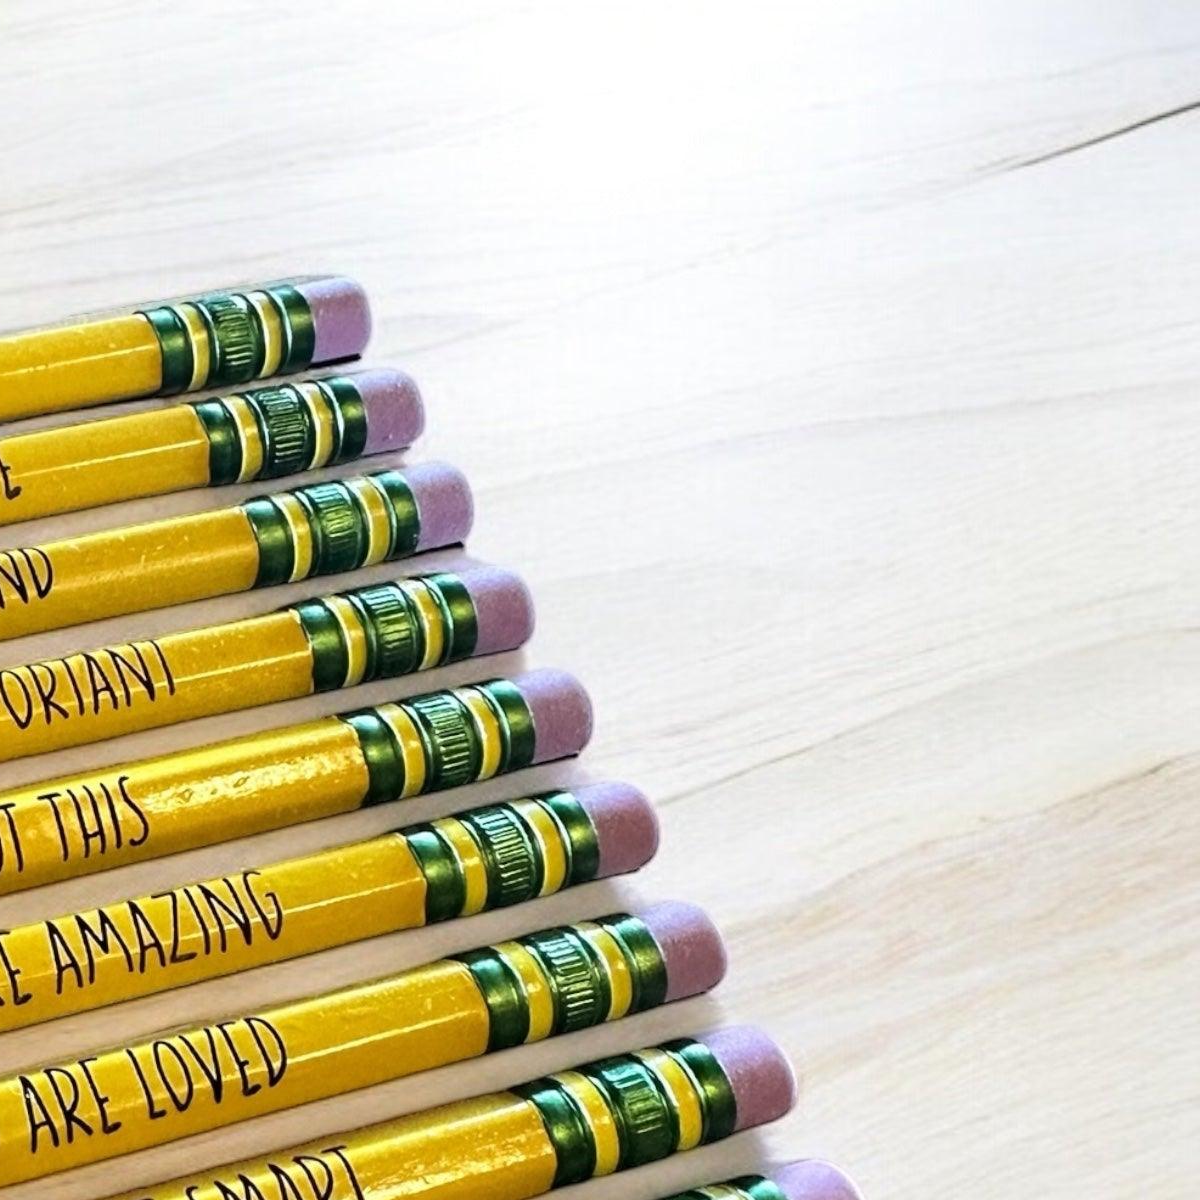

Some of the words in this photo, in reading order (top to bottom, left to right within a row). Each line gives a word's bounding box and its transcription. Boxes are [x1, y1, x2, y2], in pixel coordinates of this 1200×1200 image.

[44, 776, 149, 862] THIS
[45, 870, 283, 995] AMAZING
[18, 1057, 122, 1154] ARE
[126, 1017, 289, 1121] LOVED
